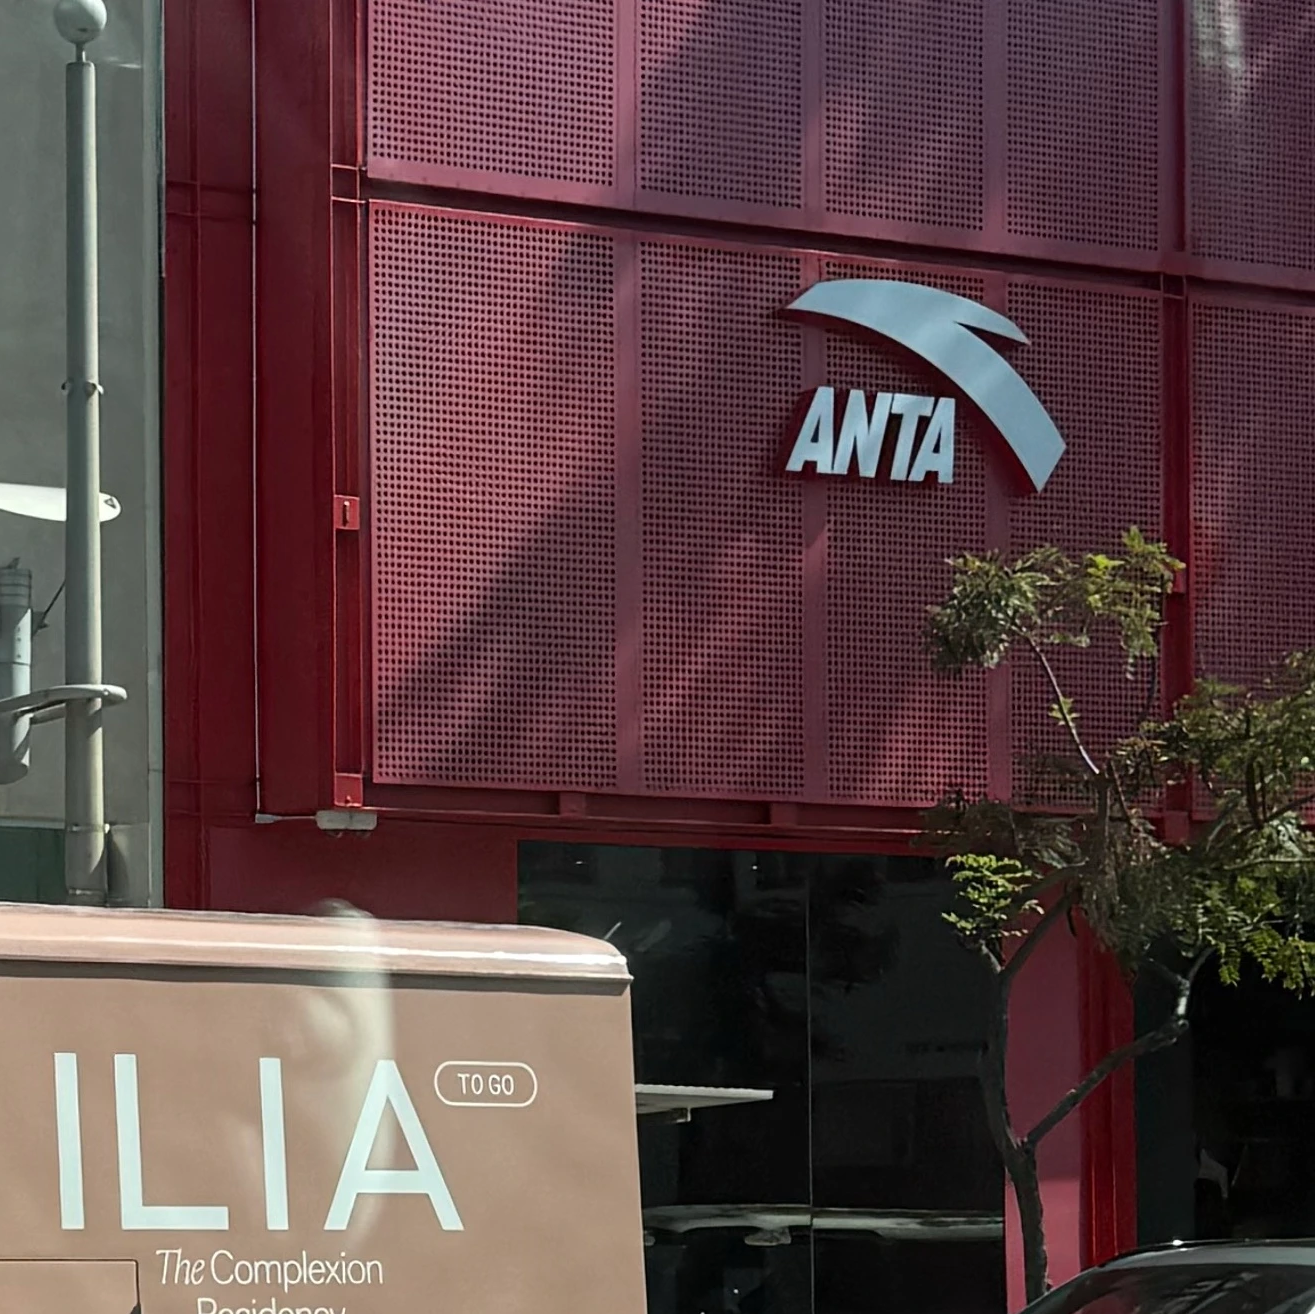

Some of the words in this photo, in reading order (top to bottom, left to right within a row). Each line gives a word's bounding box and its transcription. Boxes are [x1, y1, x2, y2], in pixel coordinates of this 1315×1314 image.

[786, 386, 955, 483] ANTA
[457, 1073, 484, 1095] TO
[488, 1074, 514, 1095] GO
[54, 1053, 464, 1230] ILIA
[156, 1248, 205, 1285] The
[210, 1249, 384, 1293] Complexion
